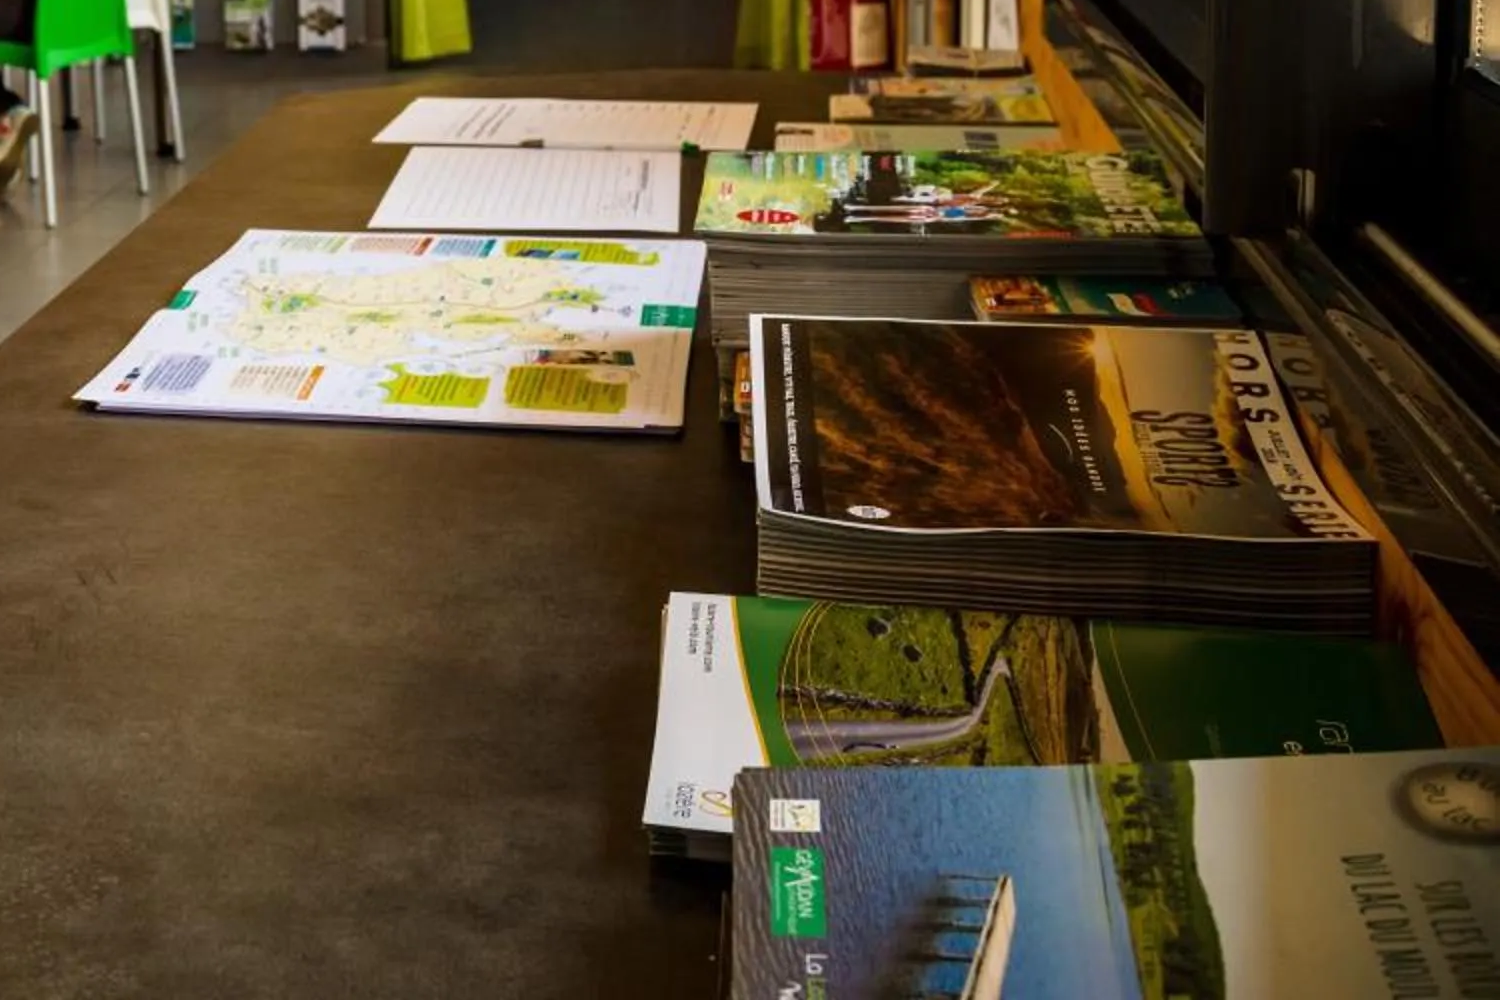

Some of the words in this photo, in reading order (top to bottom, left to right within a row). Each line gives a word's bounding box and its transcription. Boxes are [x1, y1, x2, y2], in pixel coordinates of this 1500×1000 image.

[1214, 332, 1281, 424] HORS
[1341, 853, 1392, 876] DU
[1350, 881, 1408, 915] LAC
[1365, 917, 1419, 944] DU
[805, 952, 828, 975] La
